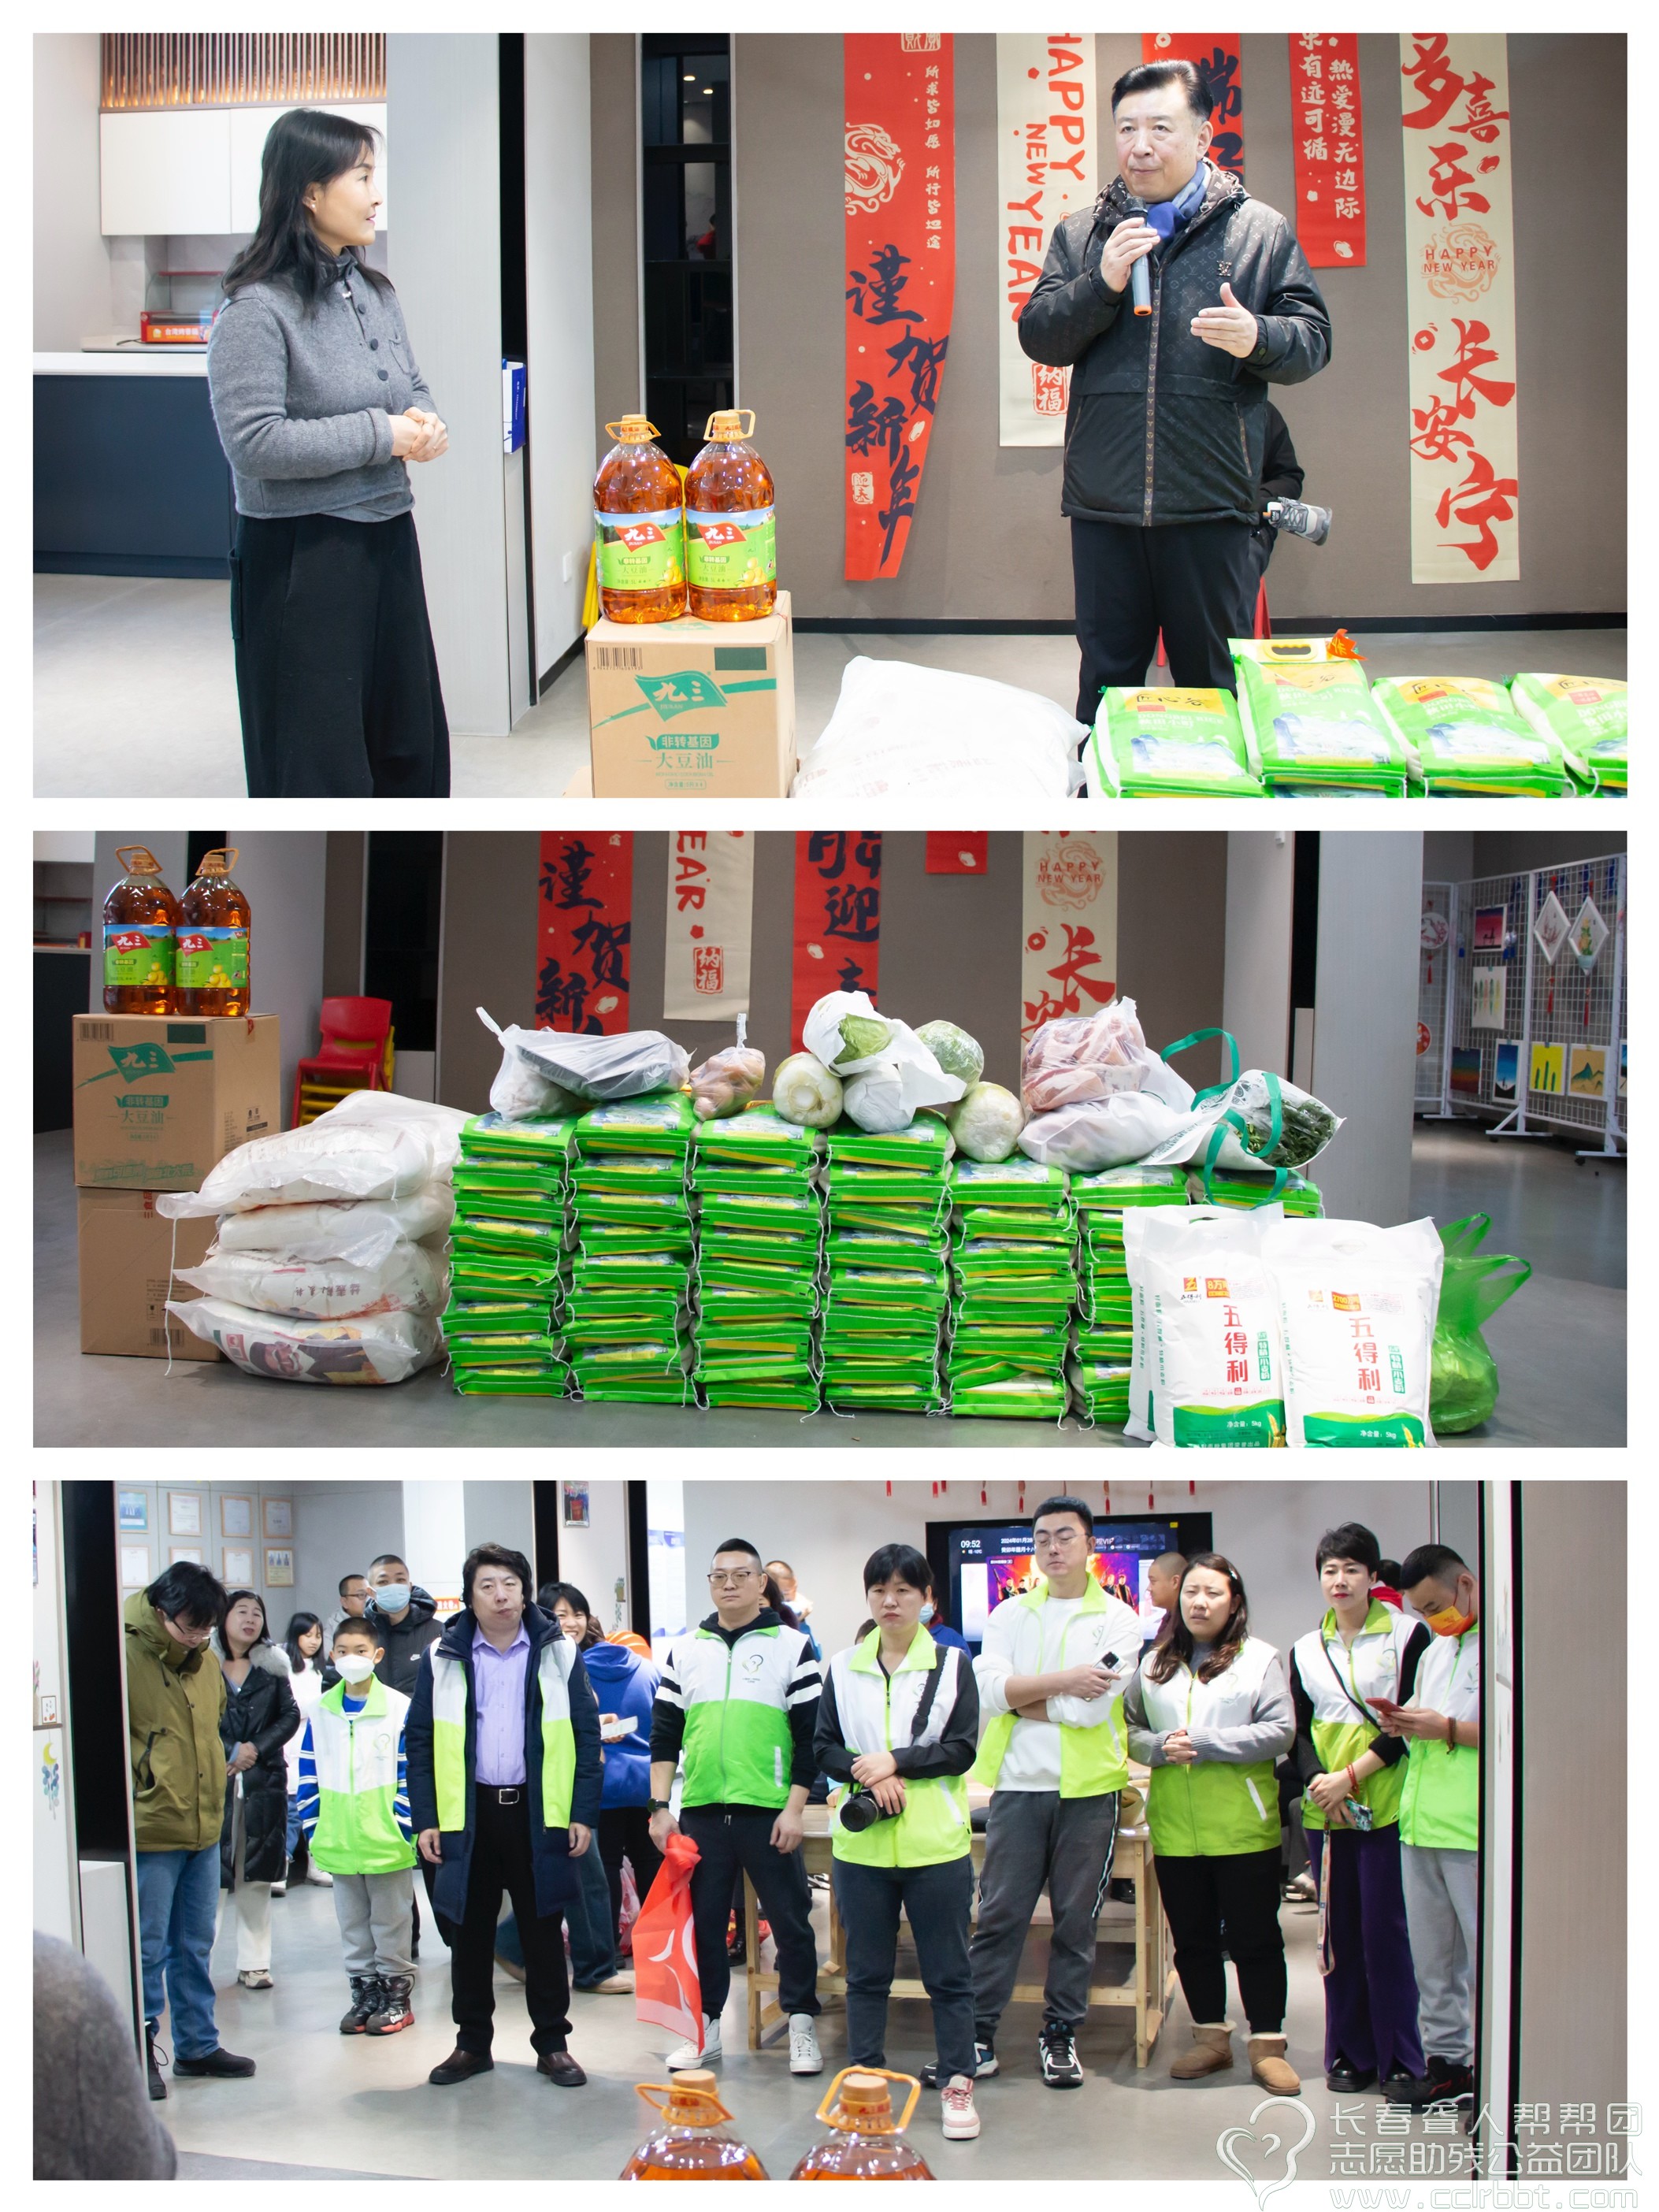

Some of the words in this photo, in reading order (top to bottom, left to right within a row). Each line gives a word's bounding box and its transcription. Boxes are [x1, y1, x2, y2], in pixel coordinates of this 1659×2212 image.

[925, 65, 941, 149] 所求皆如愿
[1329, 59, 1360, 219] 热爱漫无边际
[1026, 124, 1048, 185] NEW
[925, 165, 941, 250] 所行皆坦途
[1425, 246, 1493, 261] HAPPY
[1423, 262, 1453, 273] NEW
[1461, 259, 1495, 272] YEAR
[1037, 365, 1063, 413] 纳福
[624, 526, 655, 541] 九三
[704, 526, 735, 540] 九三
[652, 681, 704, 702] 九三
[662, 736, 712, 748] 非转基因
[655, 752, 713, 770] 大豆油
[1039, 862, 1100, 872] HAPPY
[1038, 874, 1066, 884] NEW
[1071, 873, 1101, 883] YEAR
[117, 935, 142, 946] 九三
[182, 937, 203, 948] 九三
[695, 947, 722, 992] 纳福
[121, 1051, 159, 1069] 九三
[125, 1096, 164, 1108] 非转基因
[121, 1109, 165, 1125] 大豆油
[1223, 1305, 1249, 1383] 五得利
[1349, 1317, 1381, 1391] 五得利
